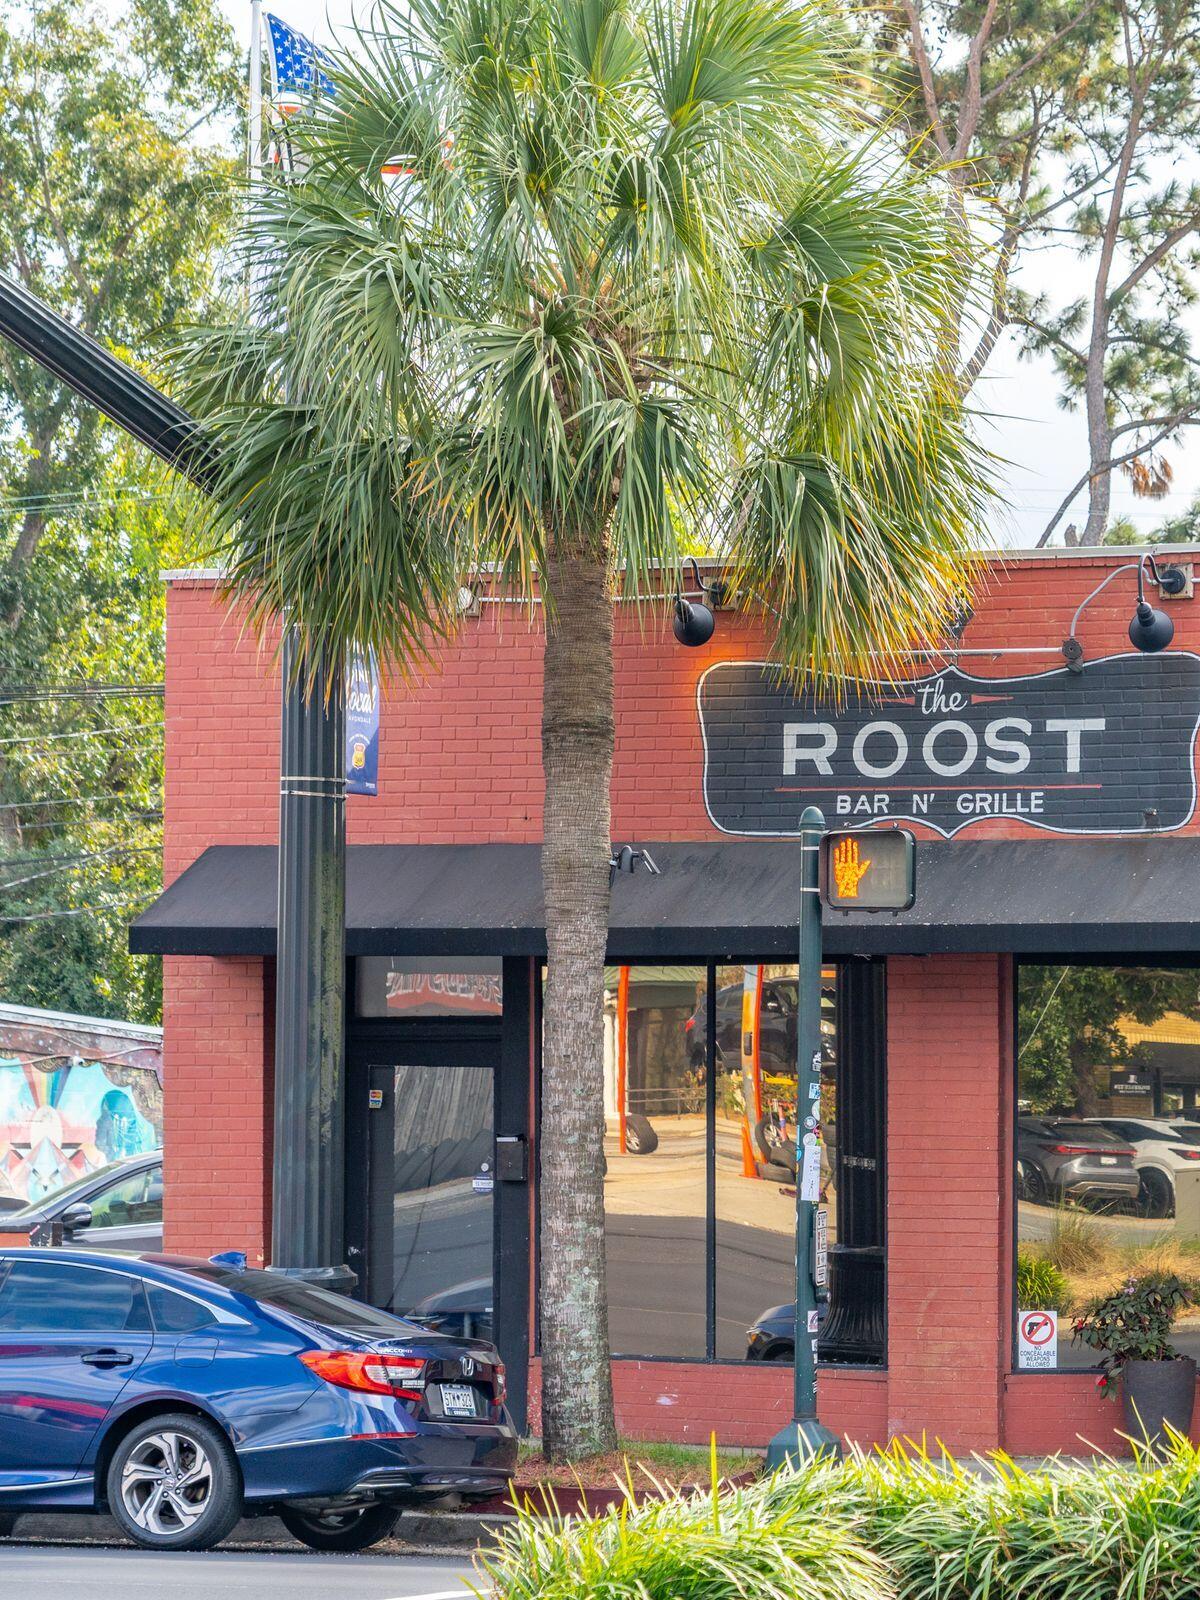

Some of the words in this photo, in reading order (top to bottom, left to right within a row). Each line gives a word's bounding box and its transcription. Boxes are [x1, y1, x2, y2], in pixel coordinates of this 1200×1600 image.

[917, 677, 968, 715] the
[782, 717, 1106, 779] ROOST
[836, 793, 890, 815] BAR
[912, 793, 936, 814] N'
[956, 792, 1045, 814] GRILLE
